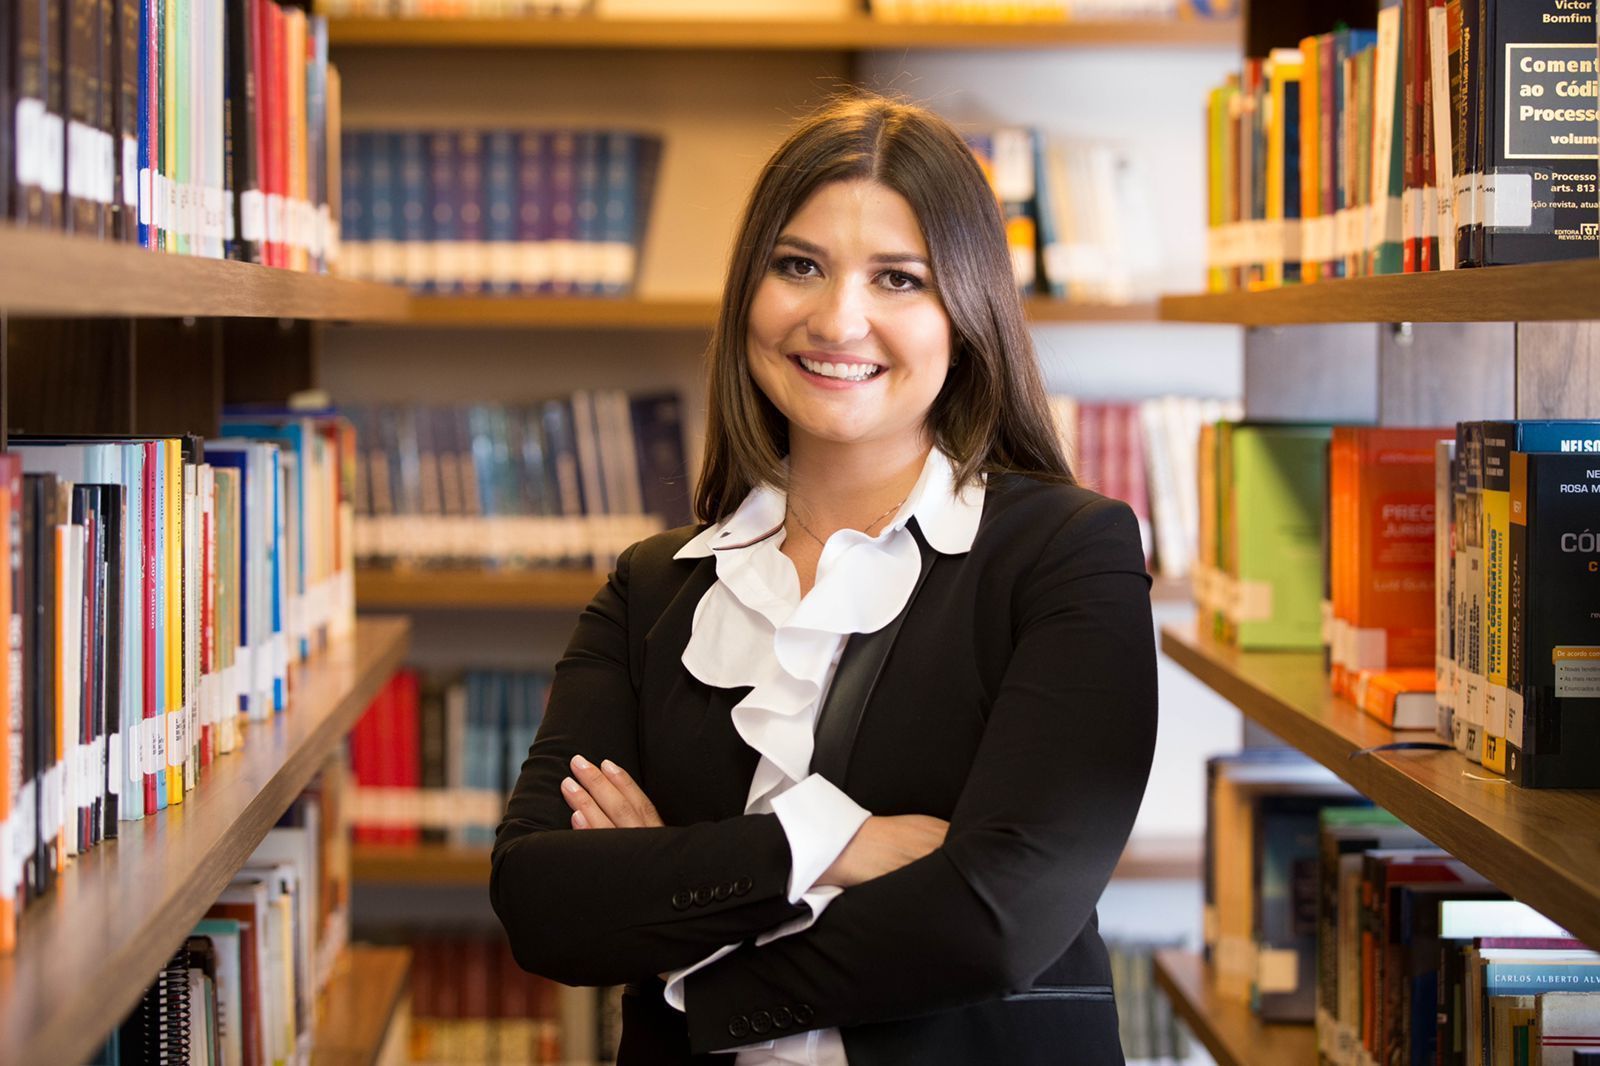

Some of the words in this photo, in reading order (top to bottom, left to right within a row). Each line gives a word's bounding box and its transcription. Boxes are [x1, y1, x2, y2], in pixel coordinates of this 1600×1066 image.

[1555, 0, 1592, 10] Victor
[1542, 13, 1592, 23] Bomfim
[1519, 84, 1544, 97] ao
[1555, 80, 1598, 97] Códi
[1534, 172, 1549, 181] Do
[1551, 172, 1597, 181] Processo
[1550, 184, 1574, 193] arts.
[1576, 184, 1596, 193] 813
[1549, 200, 1579, 209] revista,
[1560, 484, 1588, 493] ROSA
[1494, 973, 1531, 983] CARLOS
[1536, 974, 1579, 984] ALBERTO
